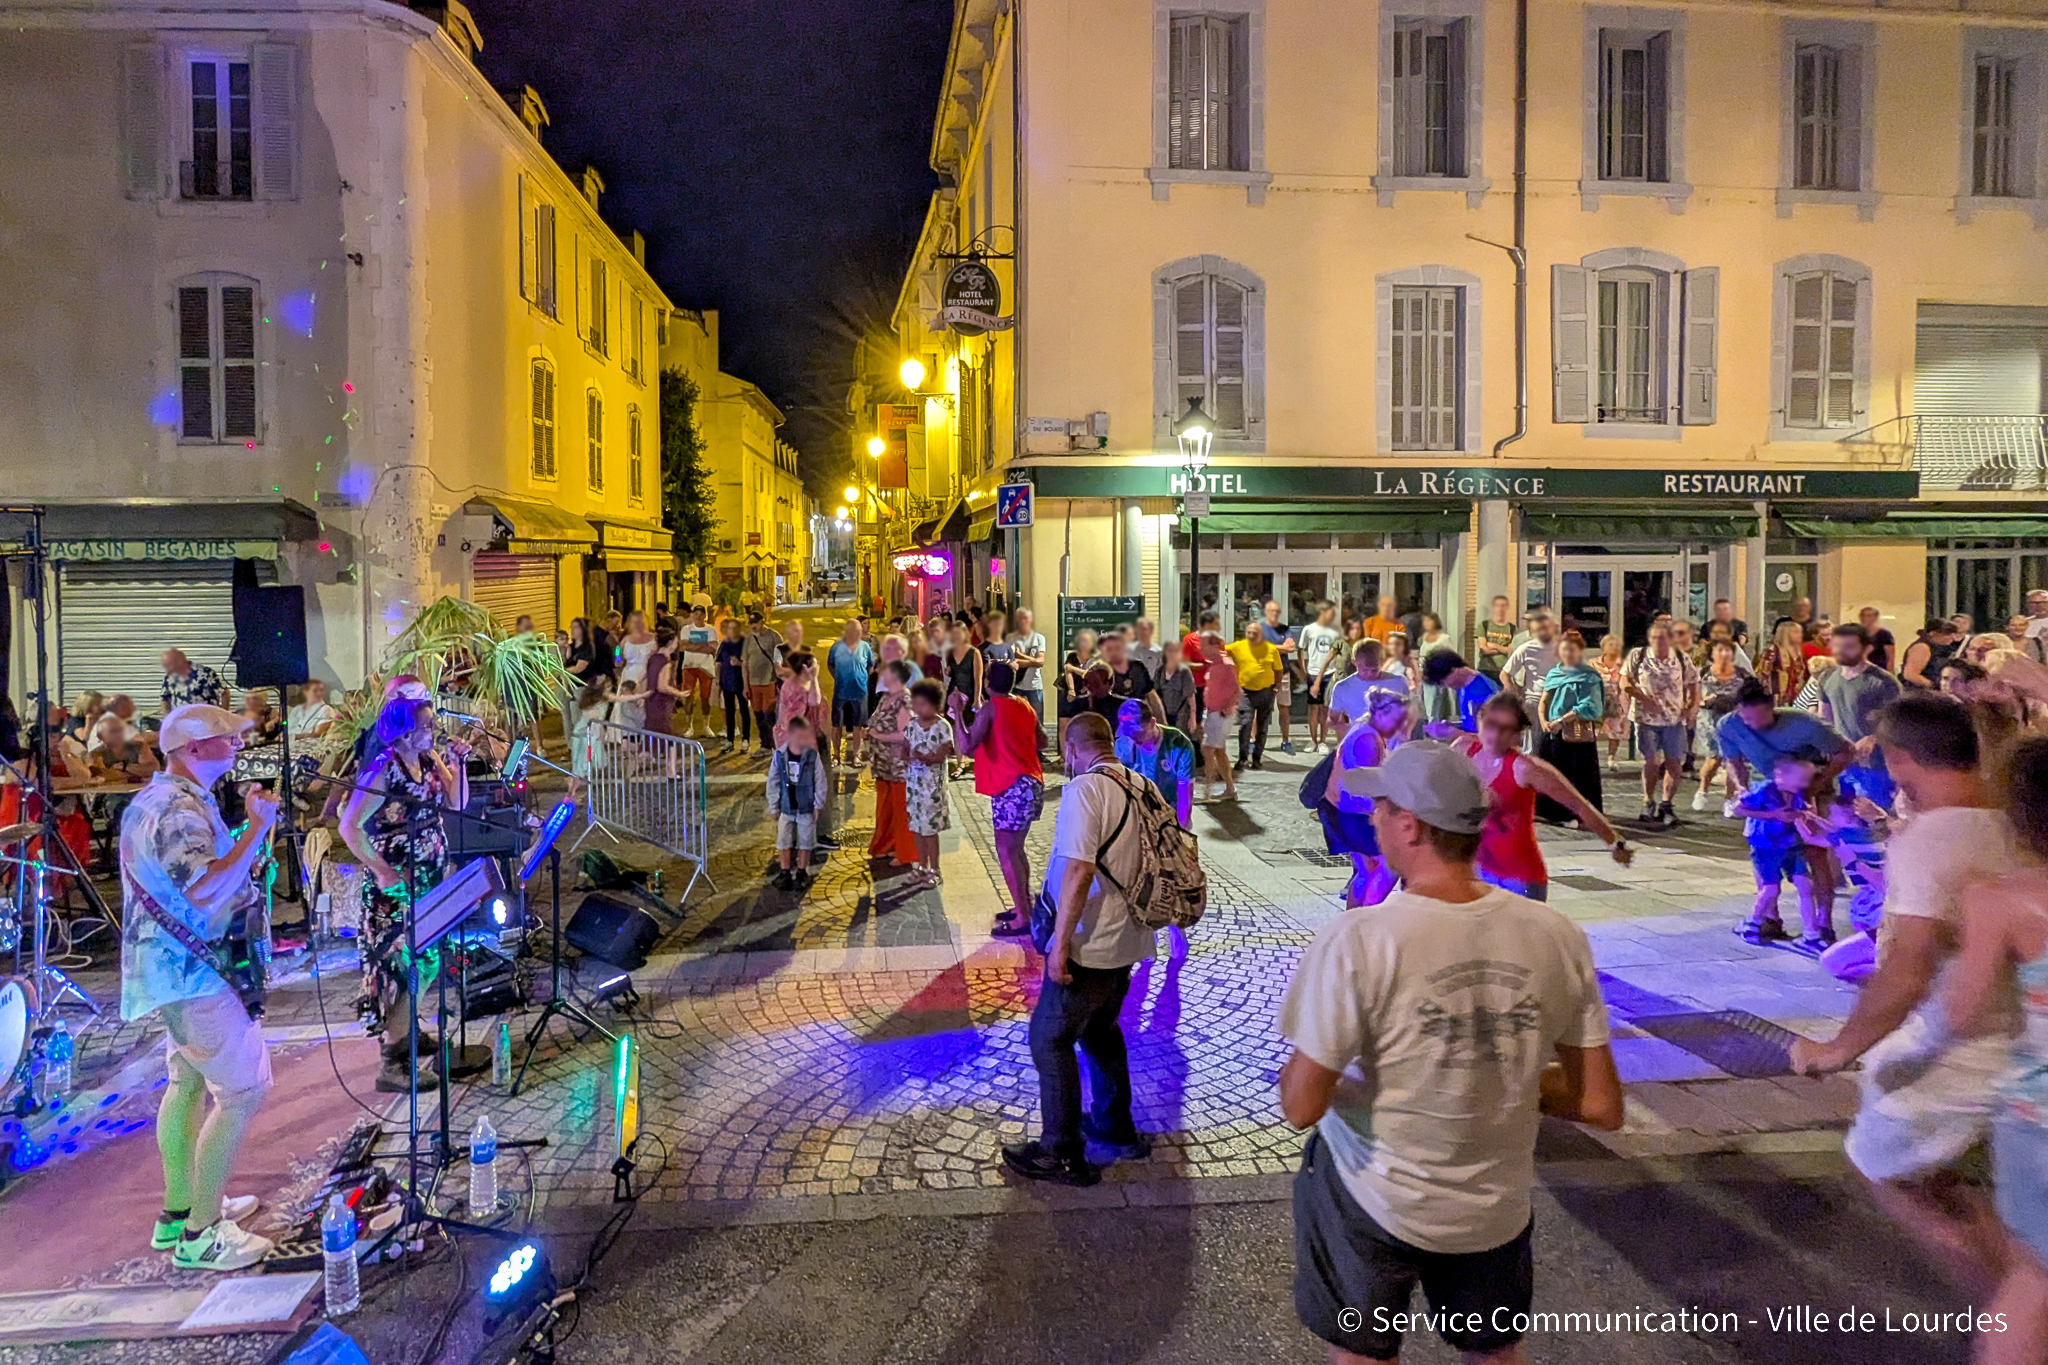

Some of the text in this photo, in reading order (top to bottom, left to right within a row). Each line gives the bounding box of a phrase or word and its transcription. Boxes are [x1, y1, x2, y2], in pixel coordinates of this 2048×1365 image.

[1374, 471, 1409, 494] LA
[1419, 469, 1545, 495] RÉGENCE
[1664, 474, 1805, 493] RESTAURANT
